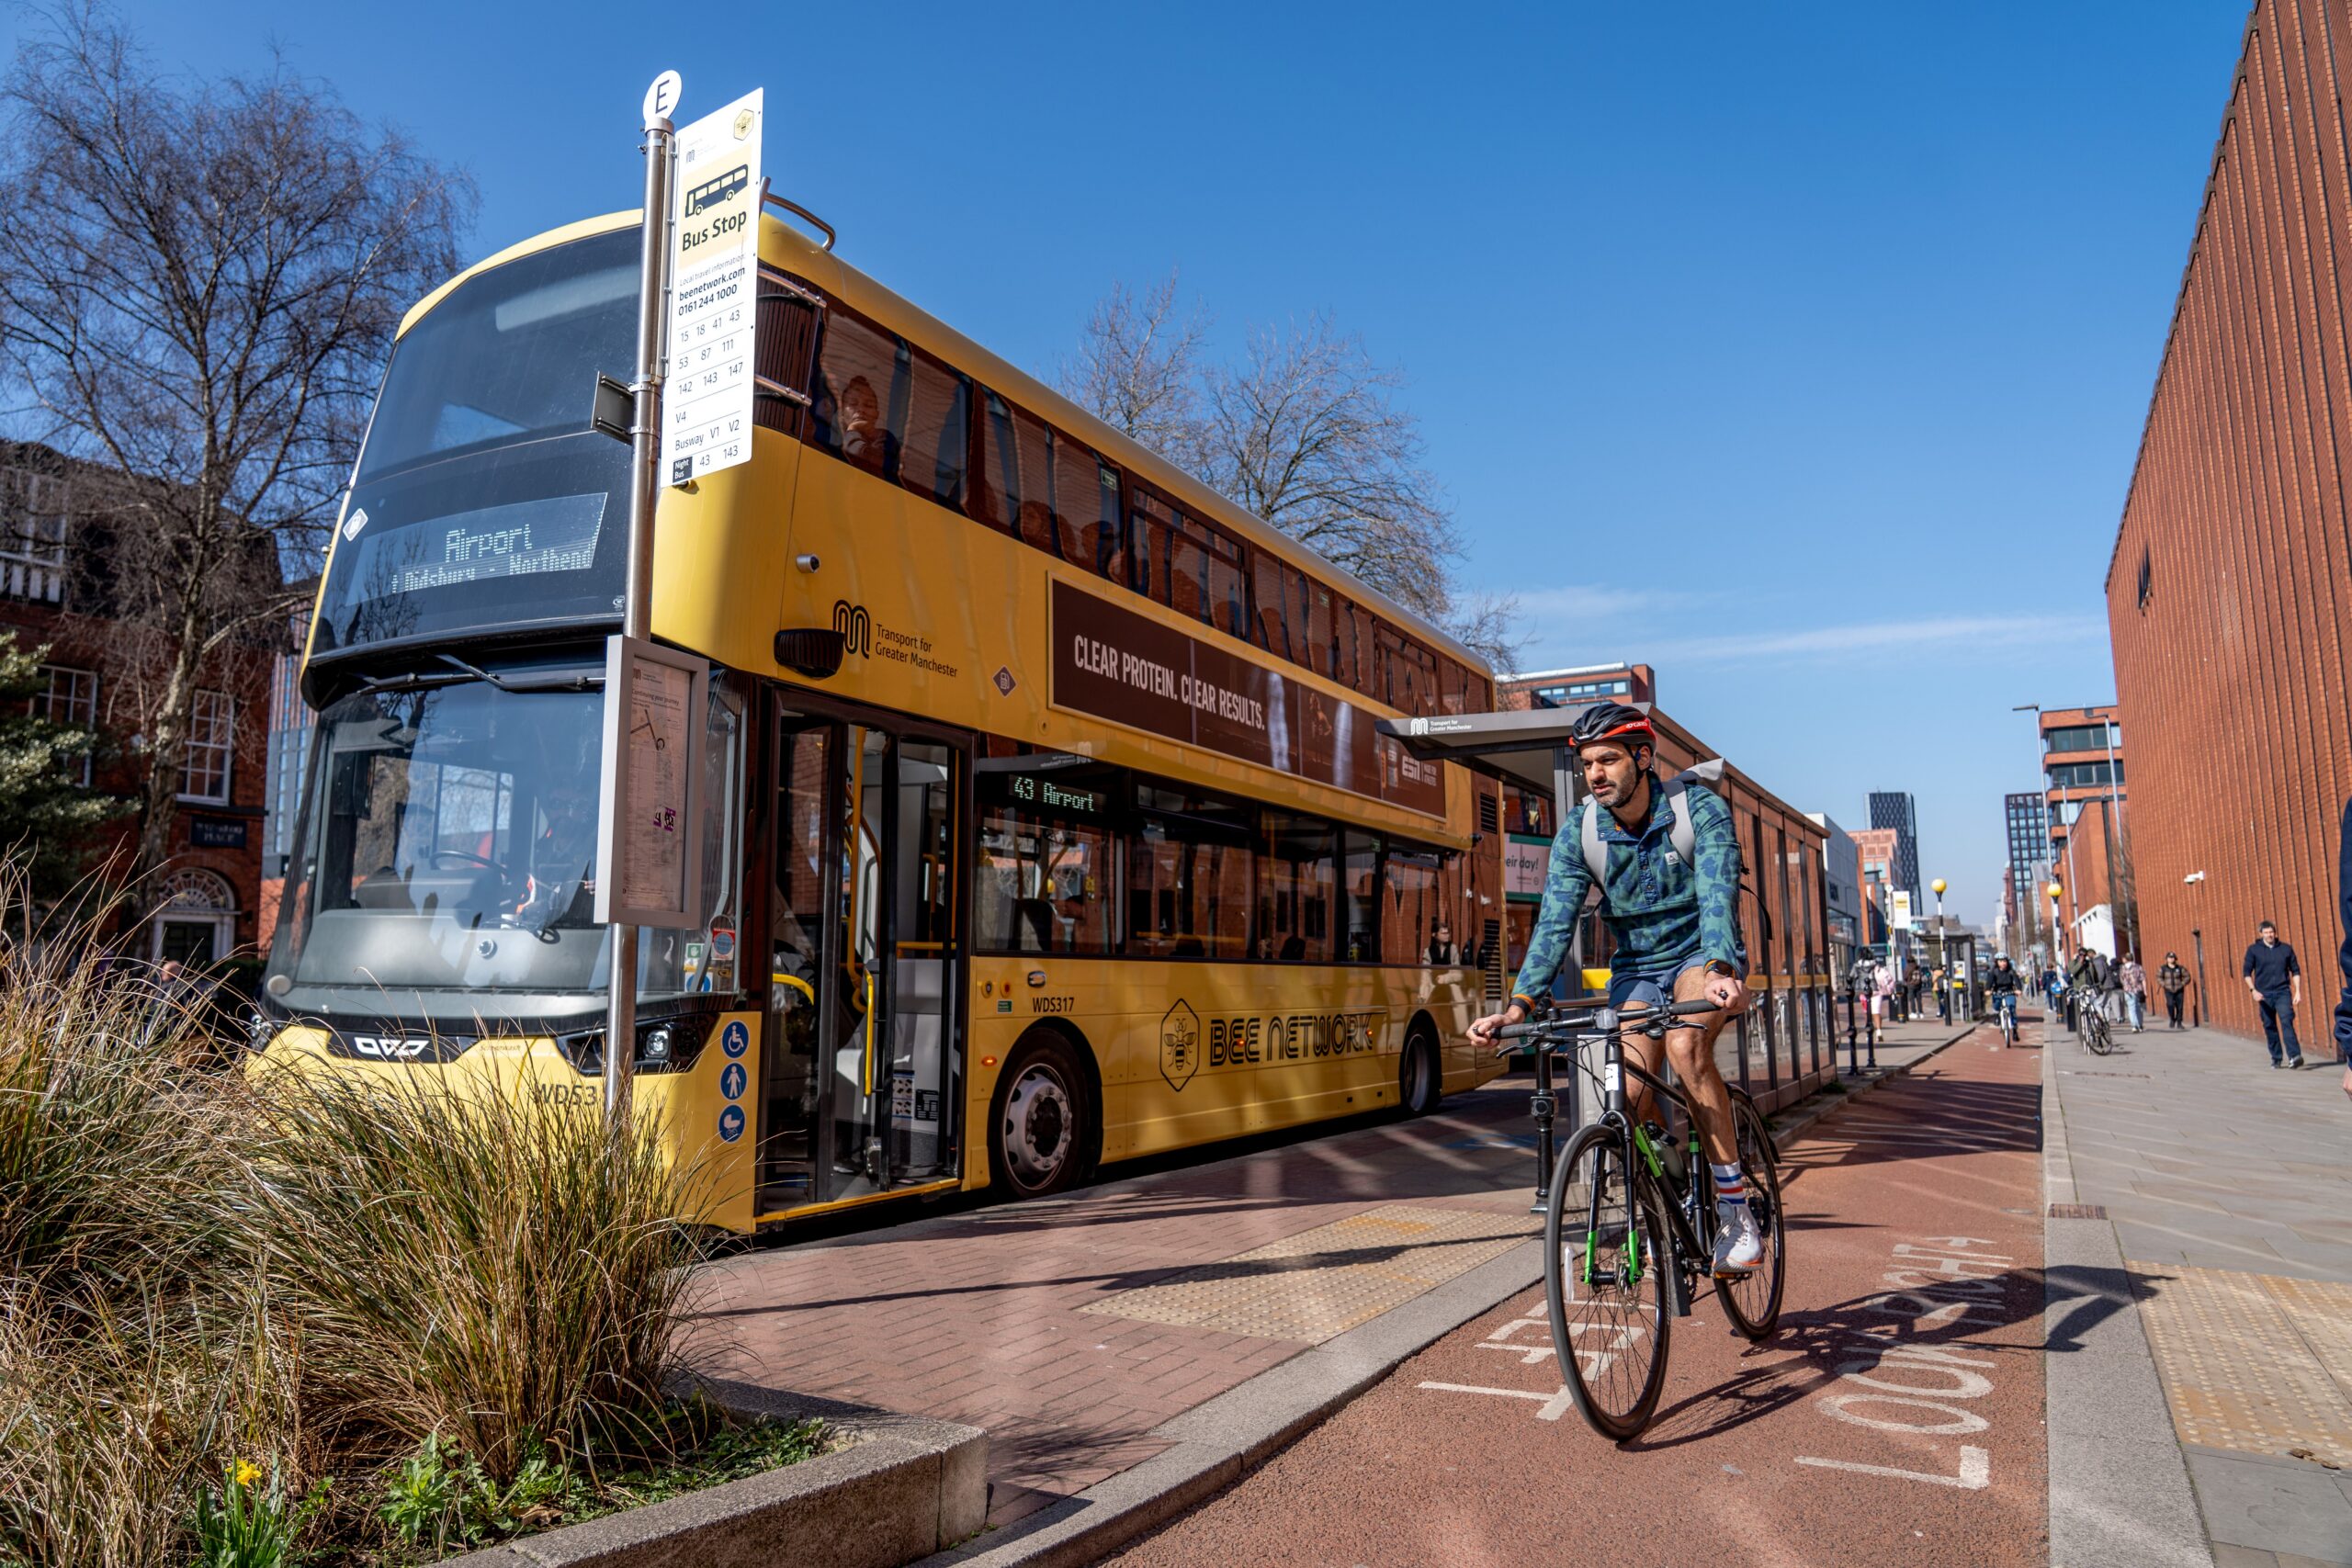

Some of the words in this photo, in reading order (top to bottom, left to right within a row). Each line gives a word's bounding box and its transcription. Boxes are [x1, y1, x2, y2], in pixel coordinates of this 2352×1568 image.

[654, 79, 671, 115] E
[682, 229, 708, 252] Bus
[712, 210, 748, 239] Stop
[679, 266, 746, 301] beenetwork.com
[680, 274, 695, 287] Local
[695, 266, 711, 279] travel
[678, 300, 697, 317] 0161
[698, 293, 715, 309] 244
[717, 284, 738, 300] 1000
[680, 330, 689, 343] 15
[696, 323, 706, 337] 18
[712, 317, 722, 331] 41
[729, 310, 741, 323] 43
[678, 355, 689, 370] 53
[700, 346, 711, 362] 87
[721, 338, 734, 354] 111
[678, 380, 693, 396] 142
[703, 371, 718, 387] 143
[729, 361, 743, 377] 147
[675, 410, 686, 424] V4
[674, 434, 705, 451] Busway
[710, 426, 719, 440] V1
[729, 419, 741, 433] V2
[674, 459, 689, 470] Night
[699, 454, 710, 467] 43
[723, 446, 739, 460] 143
[674, 471, 684, 479] Bus
[445, 524, 534, 563] Airport
[404, 567, 476, 591] Didsbury
[876, 623, 918, 648] Transport
[920, 639, 933, 653] for
[876, 641, 909, 662] Greater
[910, 652, 958, 678] Manchester
[1074, 634, 1118, 681] CLEAR
[1123, 651, 1178, 700] PROTEIN.
[1181, 673, 1216, 714] CLEAR
[1219, 688, 1265, 731] RESULTS.
[1014, 777, 1035, 800] 43
[1043, 782, 1095, 812] Airport
[1505, 855, 1518, 868] eir
[1519, 856, 1539, 873] day!
[1032, 997, 1075, 1013] WDS317
[1209, 1017, 1261, 1067] BEE
[1266, 1013, 1374, 1062] NETWORK
[1863, 1244, 2014, 1327] RIGHT
[1793, 1328, 1998, 1490] LOOK
